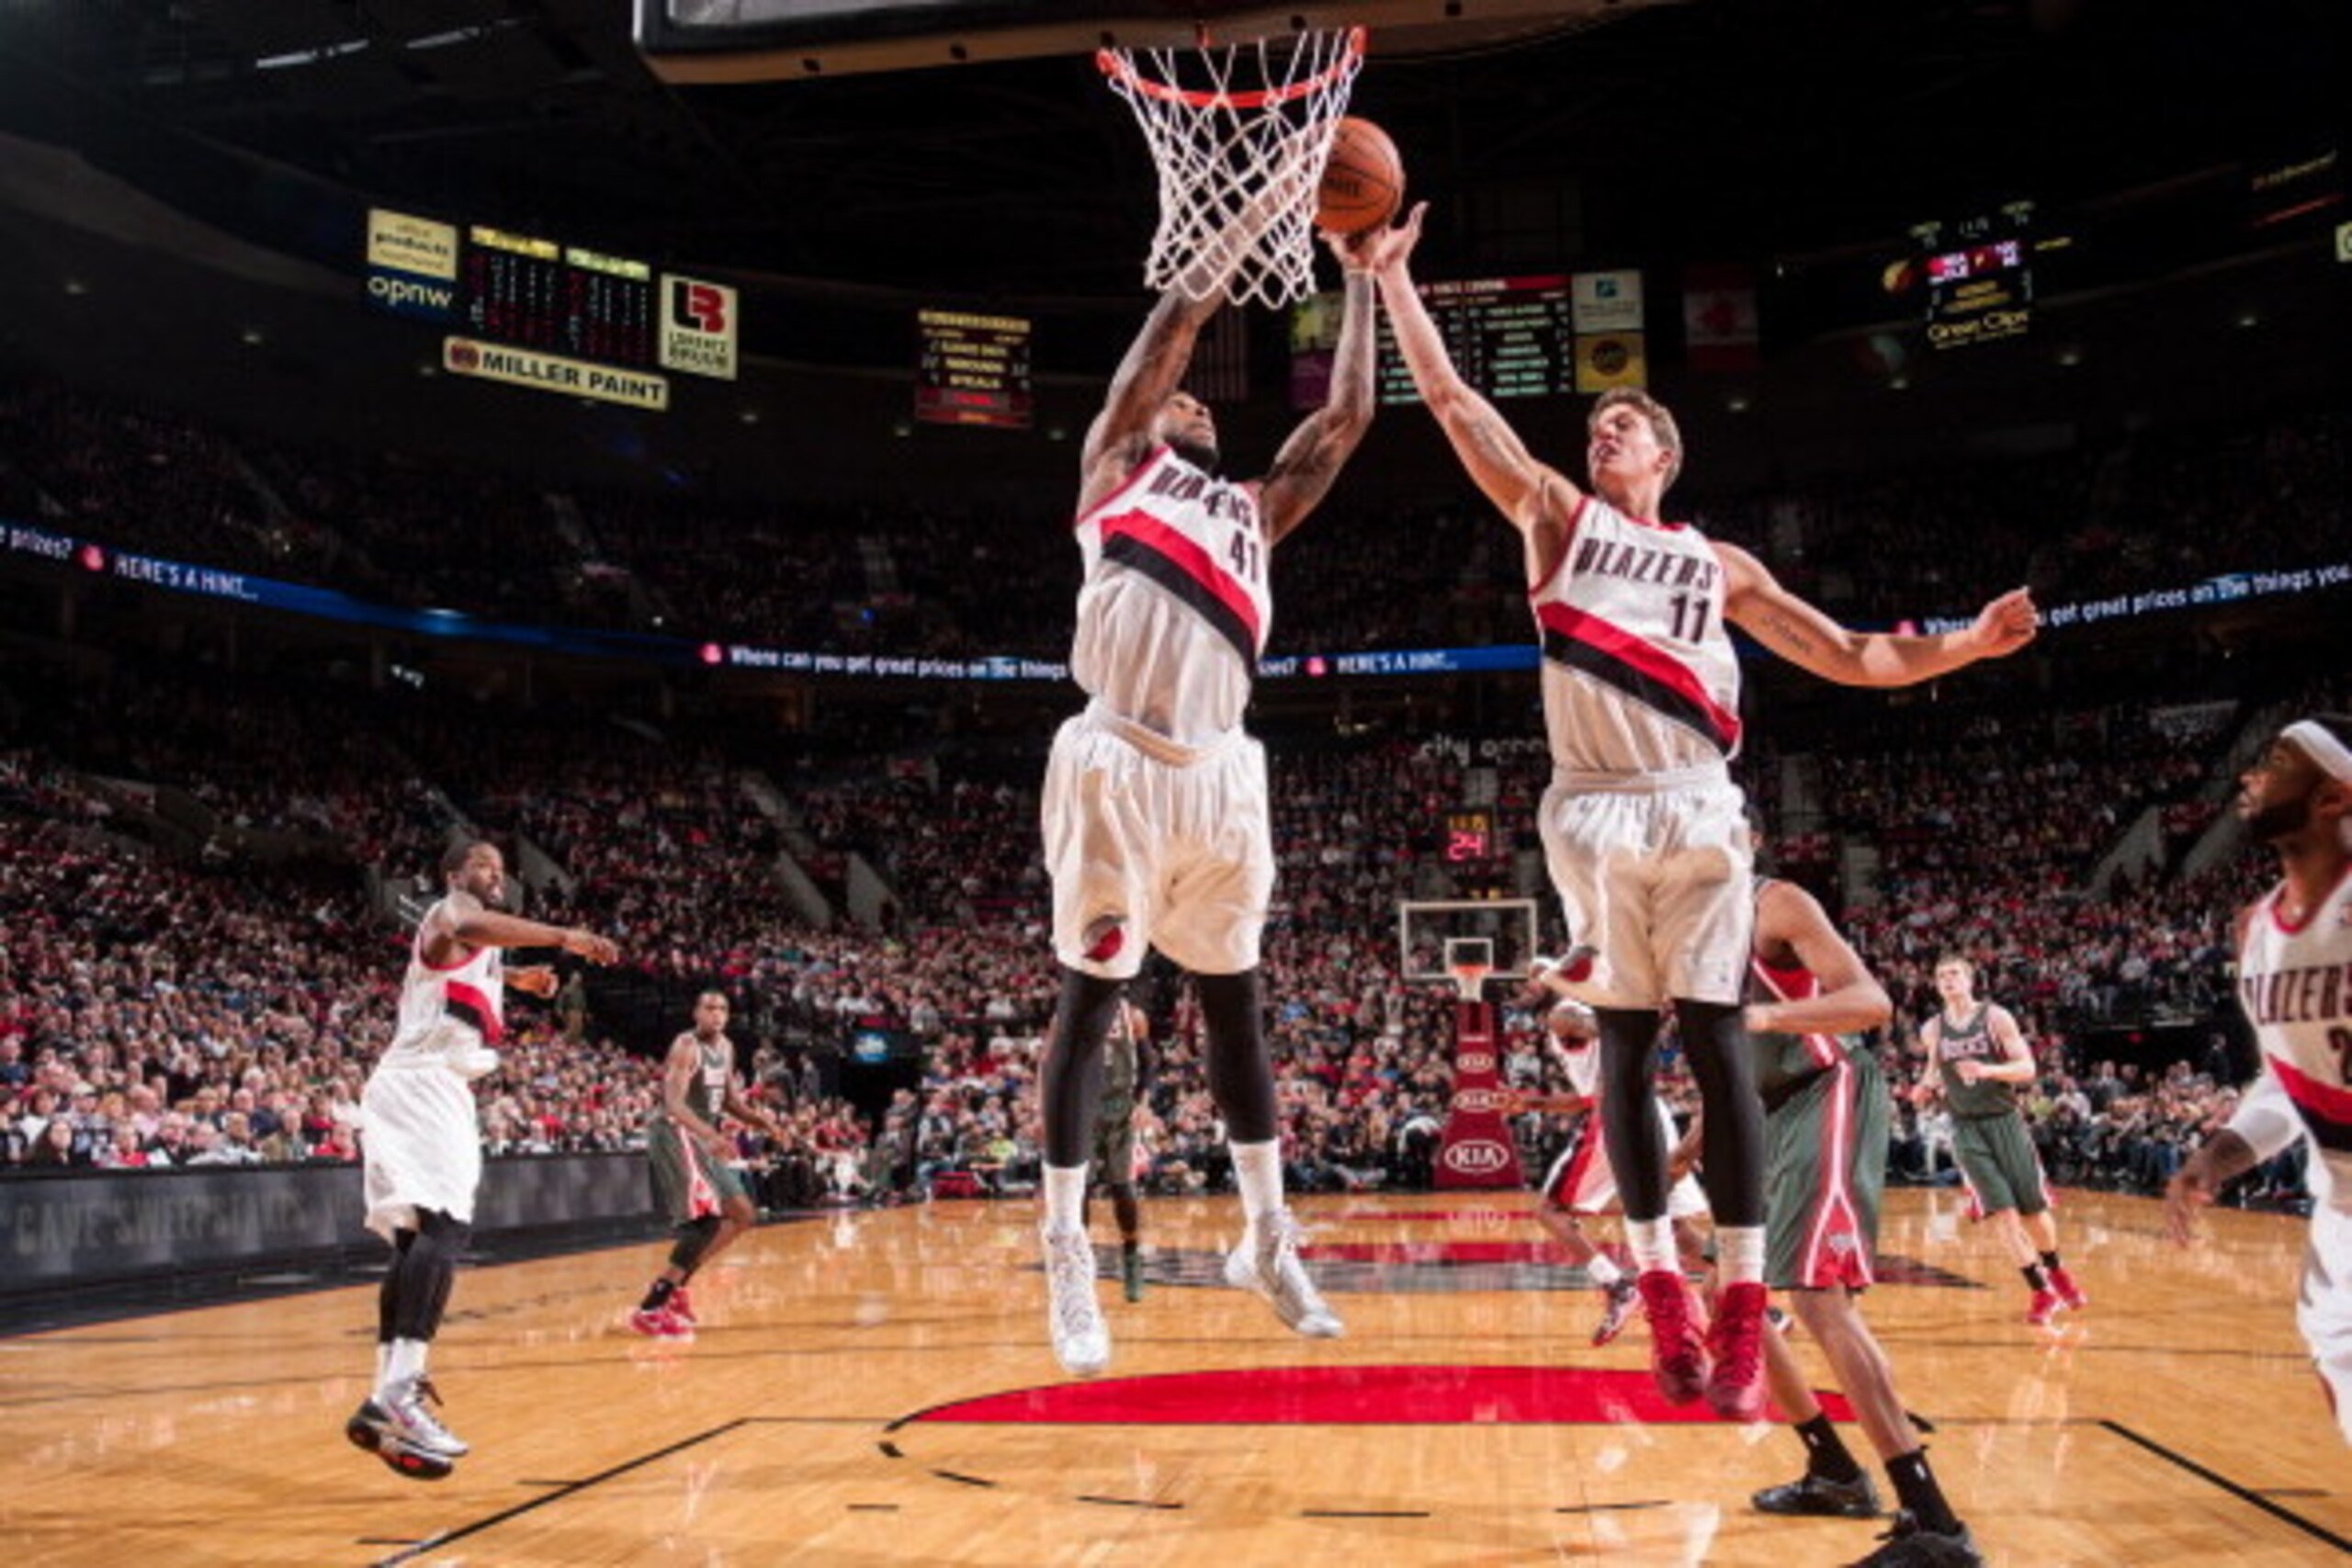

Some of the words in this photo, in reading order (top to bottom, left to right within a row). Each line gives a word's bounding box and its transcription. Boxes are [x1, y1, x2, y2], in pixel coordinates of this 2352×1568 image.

[368, 276, 453, 308] opnw
[483, 351, 580, 387] MILLER
[589, 371, 662, 401] PAINT
[1229, 530, 1258, 582] 41
[1574, 537, 1717, 591] BLAZERS
[184, 569, 198, 589] A
[2051, 604, 2078, 626] get
[2083, 596, 2130, 621] great
[2133, 590, 2186, 616] prices
[2191, 585, 2215, 603] on
[2254, 567, 2312, 592] things
[1670, 592, 1711, 644] 11
[730, 645, 778, 667] Where
[783, 651, 812, 669] can
[815, 655, 842, 672] you
[846, 654, 872, 673] get
[875, 656, 915, 676] great
[919, 658, 964, 678] prices
[968, 663, 987, 679] on
[1021, 658, 1068, 681] things
[1394, 652, 1407, 671] A
[1448, 829, 1483, 861] 24
[2244, 965, 2352, 1025] LAZER
[1454, 1146, 1498, 1168] KIA
